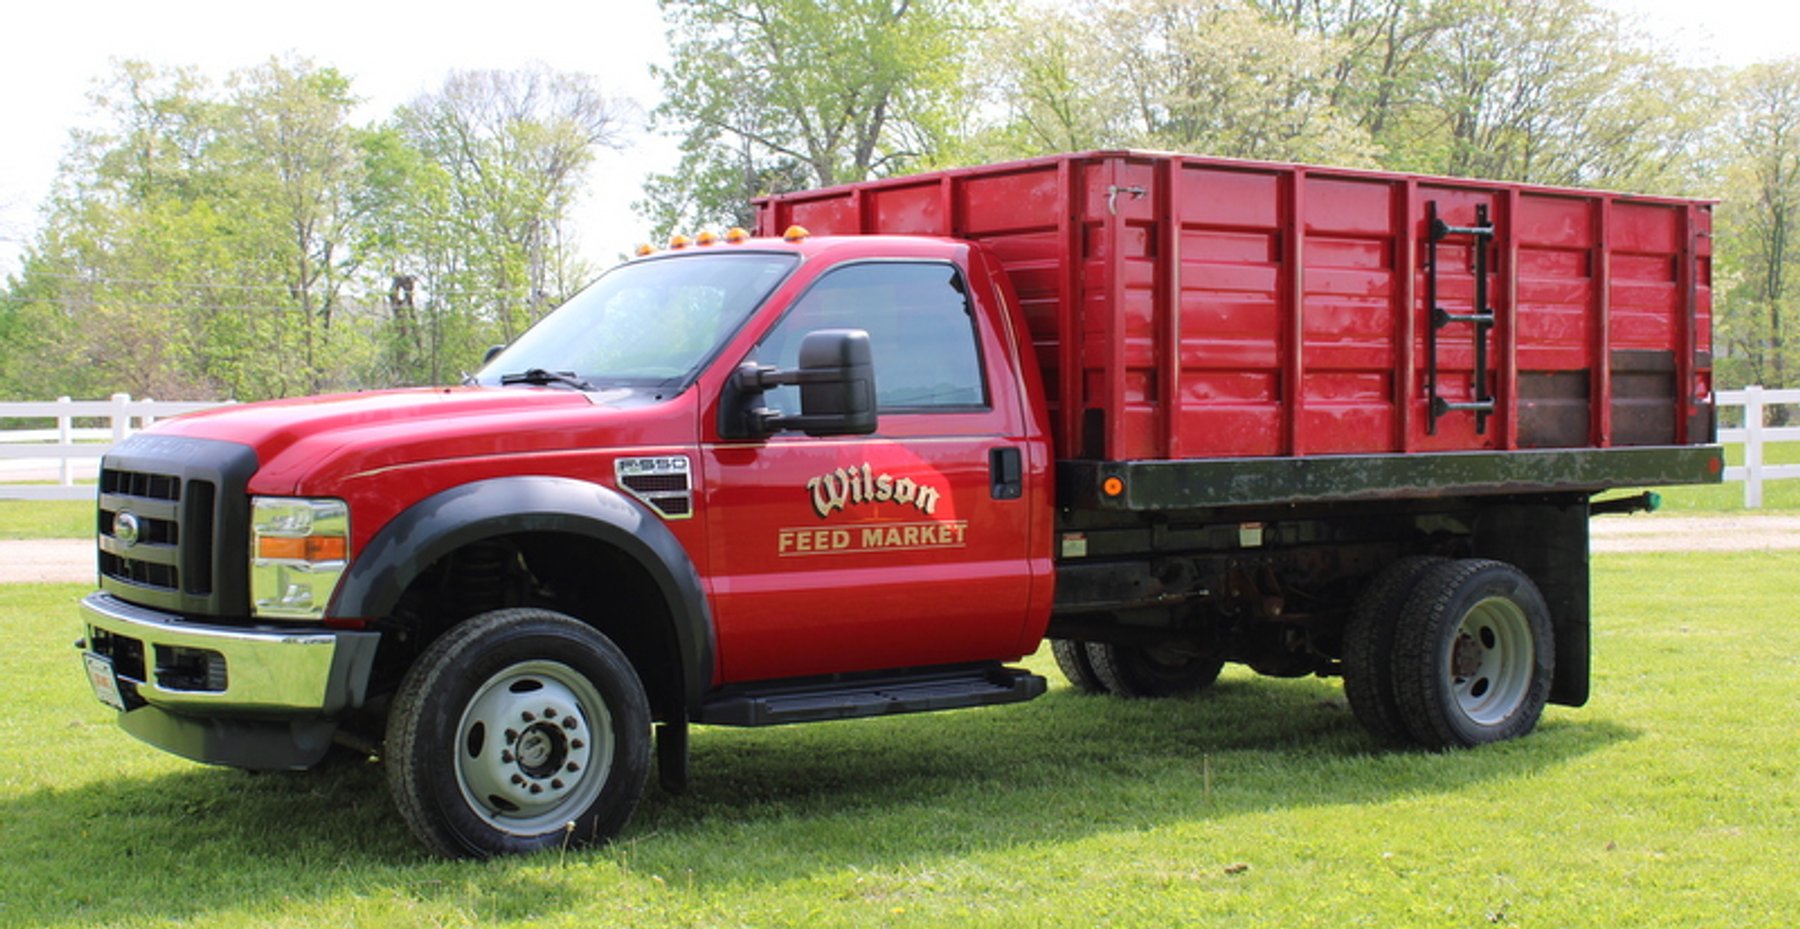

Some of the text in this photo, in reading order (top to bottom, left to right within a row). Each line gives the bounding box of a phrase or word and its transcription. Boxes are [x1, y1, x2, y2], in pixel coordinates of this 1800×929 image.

[619, 457, 688, 471] F-550
[807, 462, 940, 518] Wilson
[779, 523, 967, 552] FEED MARKET
